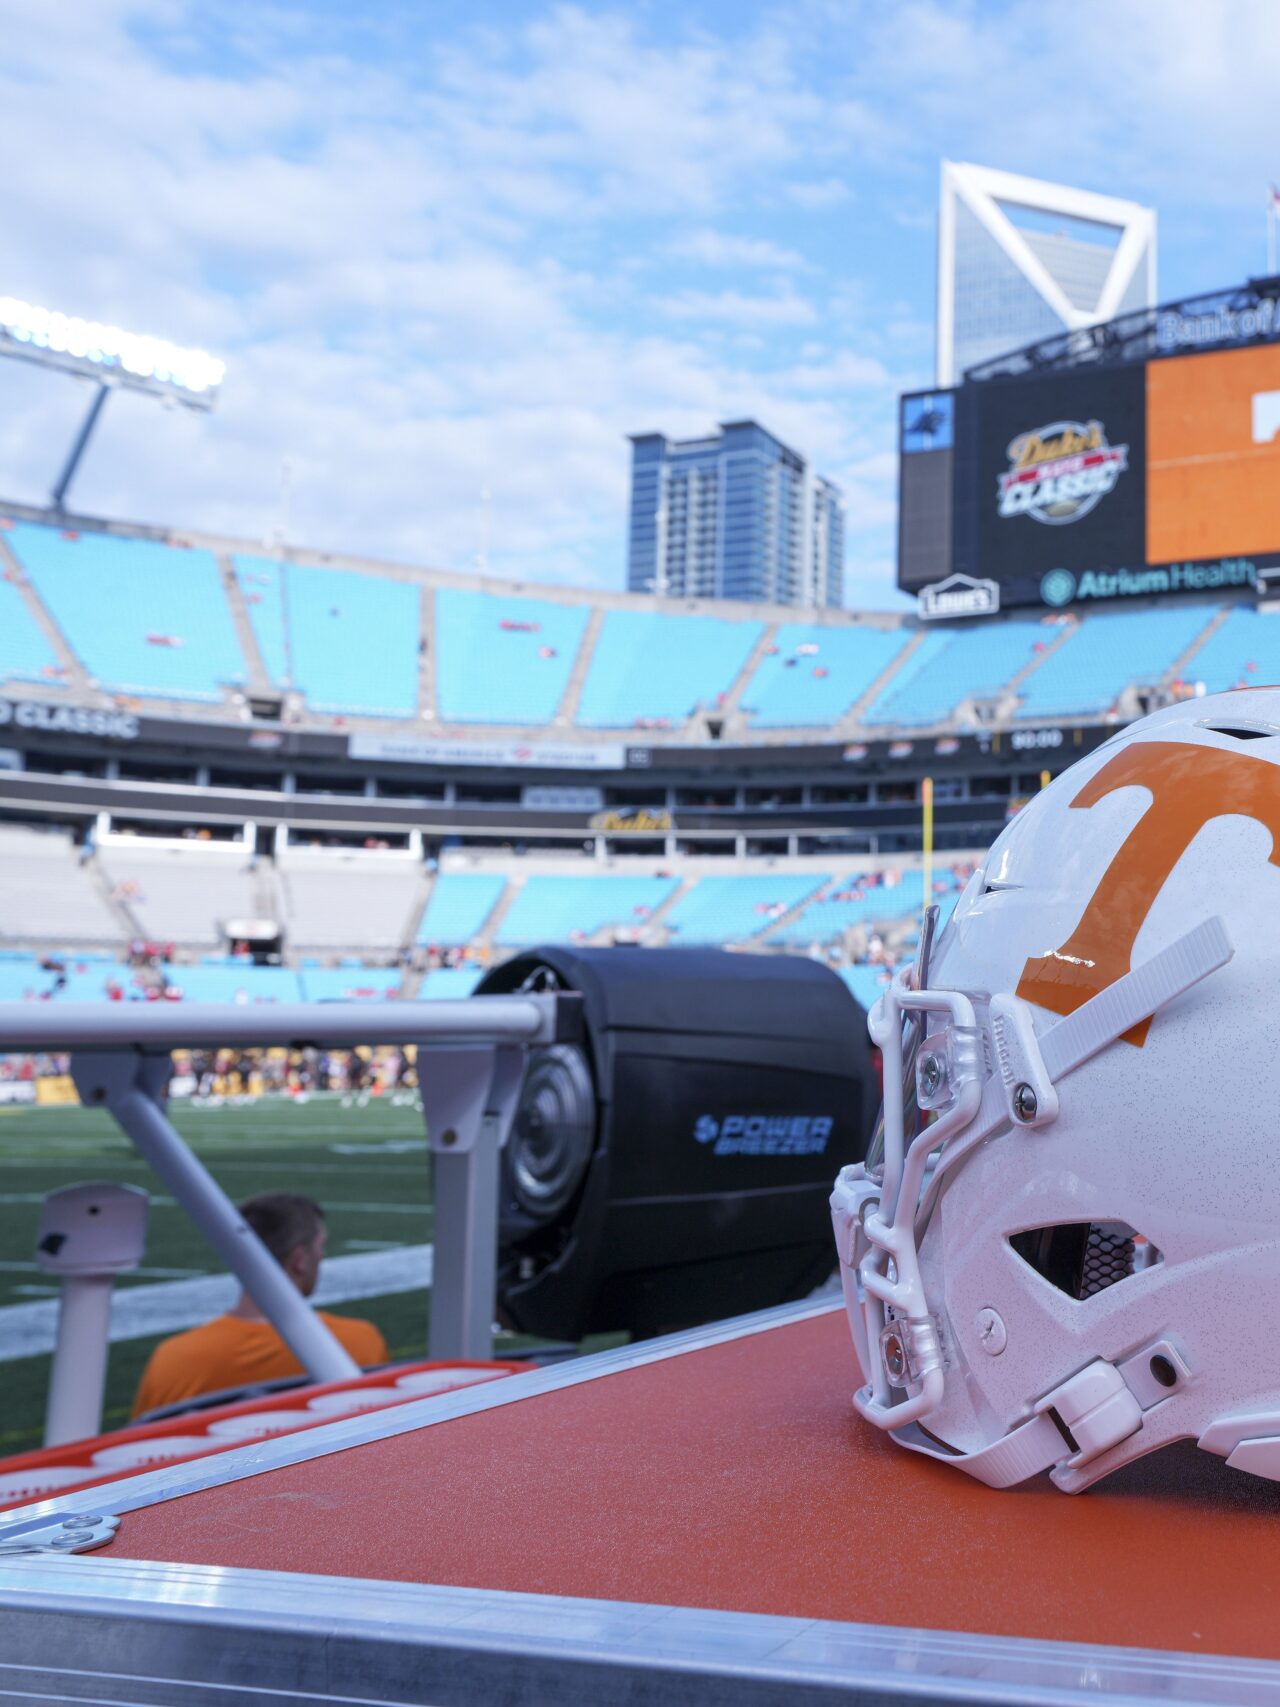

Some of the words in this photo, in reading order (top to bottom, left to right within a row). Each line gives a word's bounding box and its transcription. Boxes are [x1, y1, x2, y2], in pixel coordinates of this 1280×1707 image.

[1156, 312, 1238, 349] Bank
[1240, 299, 1274, 337] of
[1076, 569, 1170, 599] Atrium
[1170, 557, 1257, 590] Health
[720, 1115, 834, 1138] POWER
